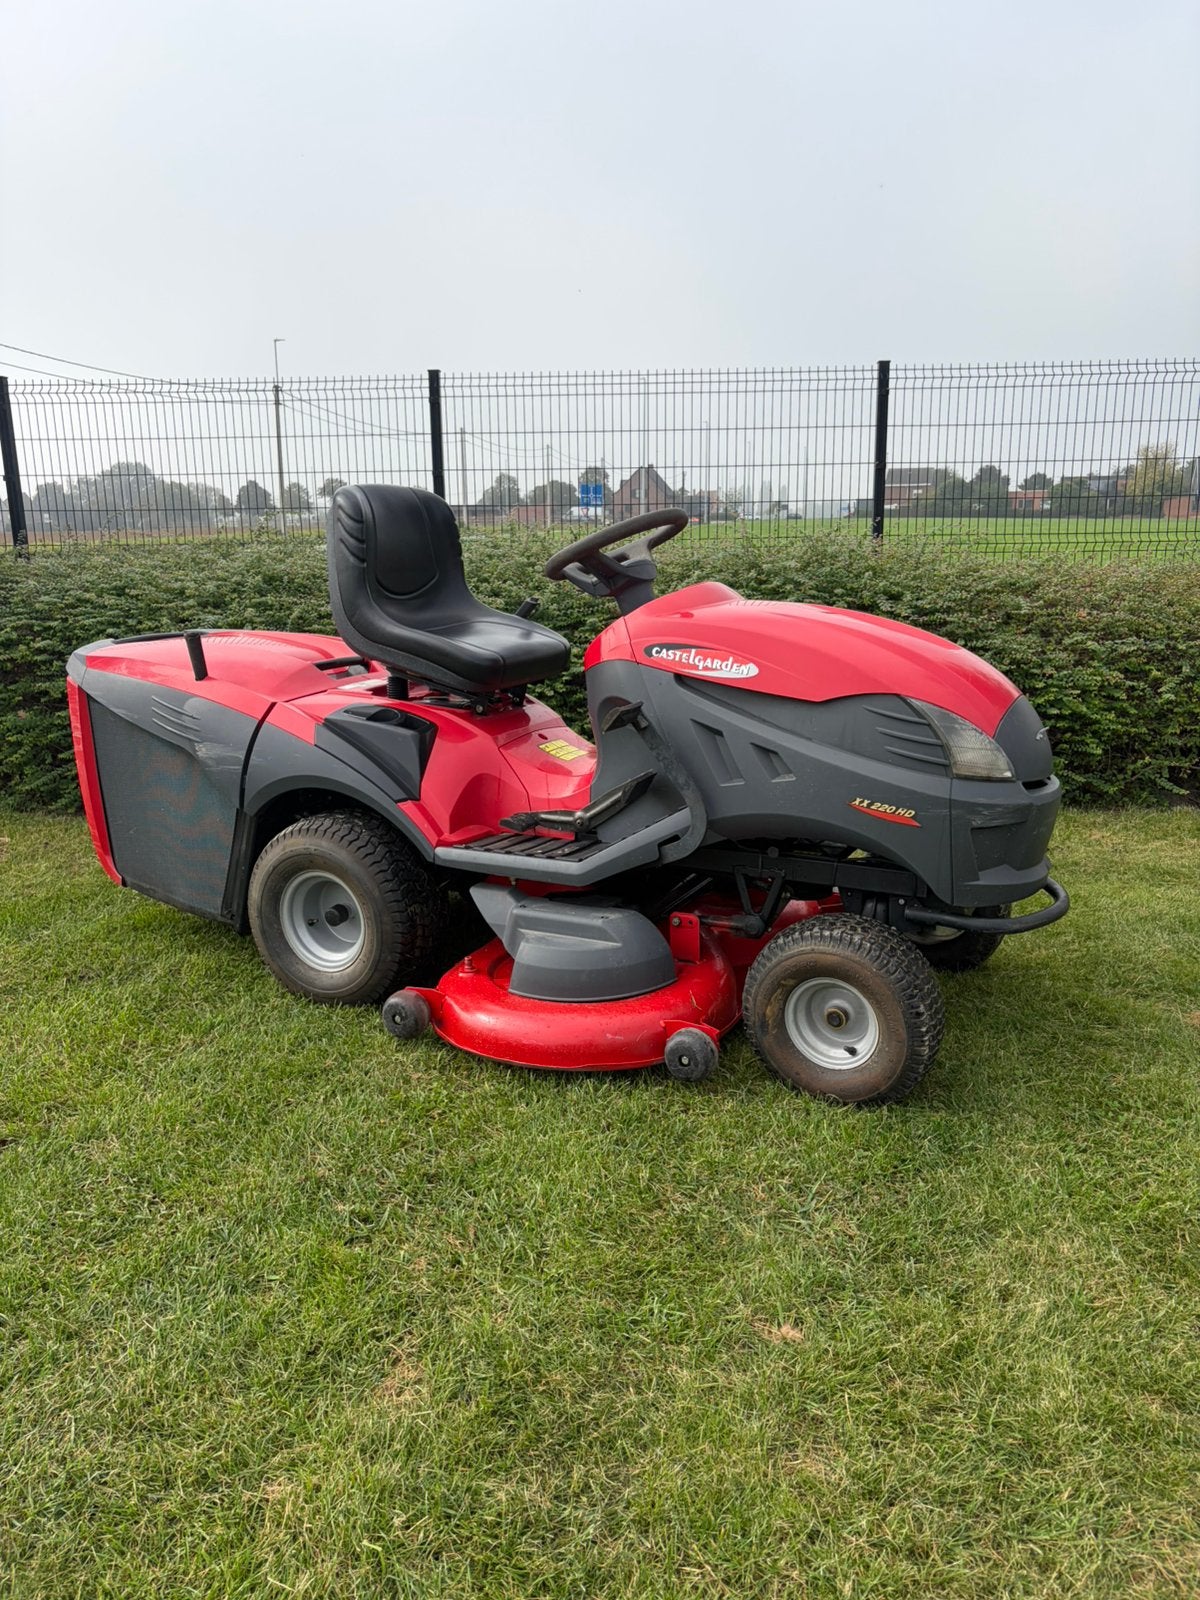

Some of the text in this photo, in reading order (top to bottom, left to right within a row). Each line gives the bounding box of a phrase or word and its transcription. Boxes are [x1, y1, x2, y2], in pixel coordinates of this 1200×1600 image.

[851, 797, 916, 818] XX 220 HD
